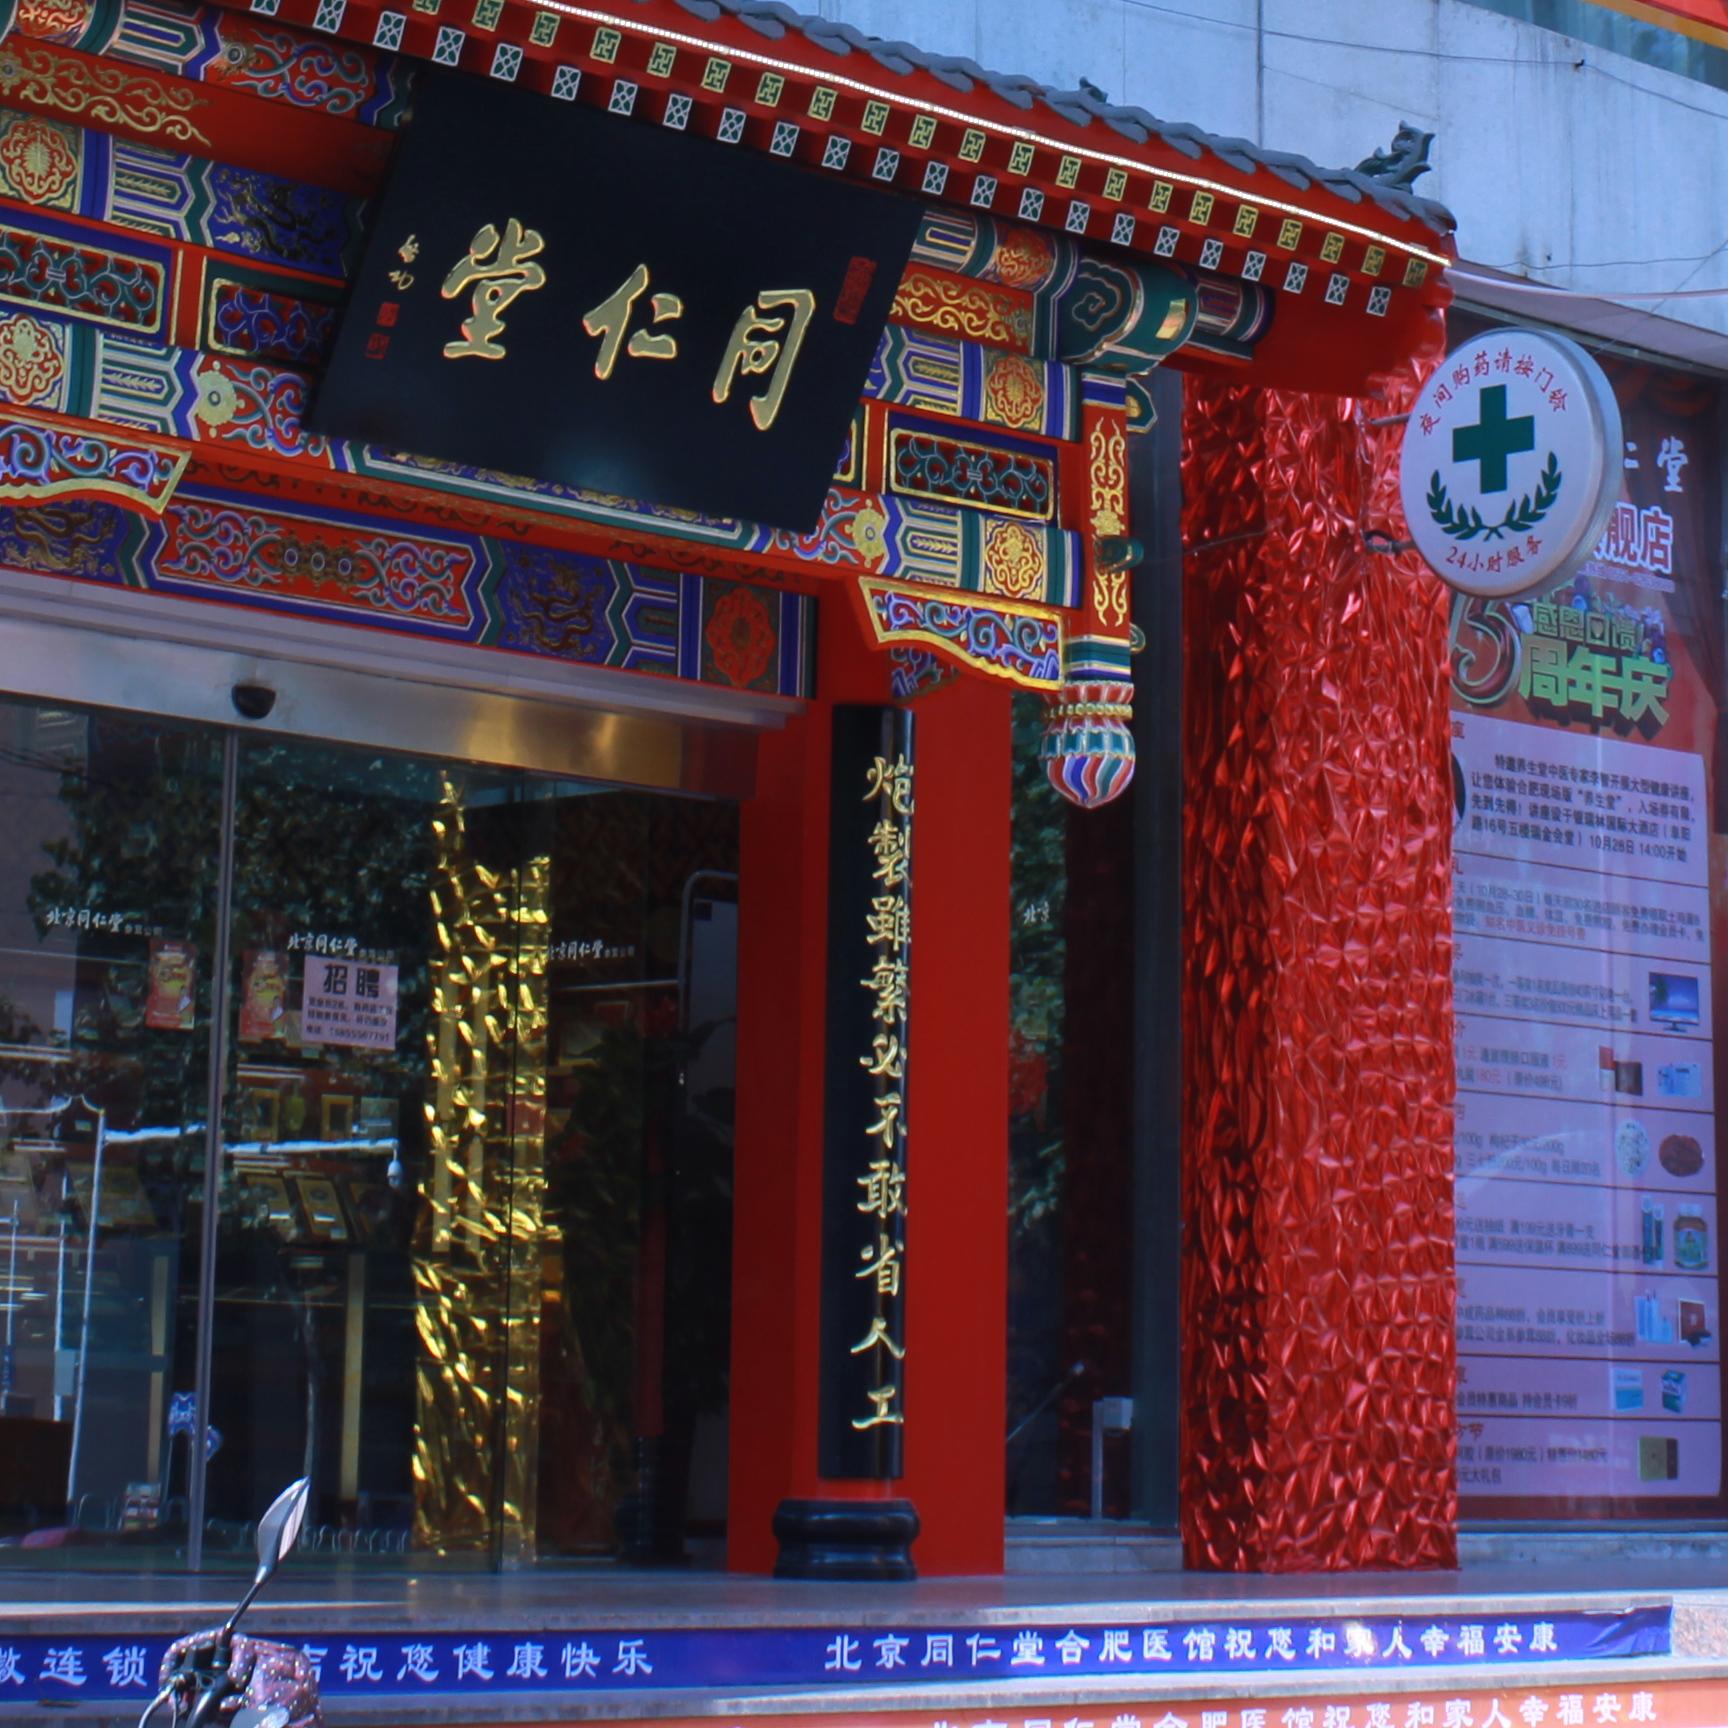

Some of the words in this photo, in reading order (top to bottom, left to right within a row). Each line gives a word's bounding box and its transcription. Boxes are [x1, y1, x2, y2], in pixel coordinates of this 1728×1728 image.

[1419, 347, 1570, 437] 夜间购药请按门铃
[1445, 534, 1544, 574] 24小时服务
[1593, 500, 1674, 574] 舰店
[1519, 633, 1670, 727] 周年庆
[46, 906, 124, 933] 北京同仁堂
[287, 931, 358, 957] 北京同仁堂
[323, 962, 380, 999] 招聘
[823, 1623, 1560, 1672] 北京同仁堂合肥医馆祝您和家人幸福安康
